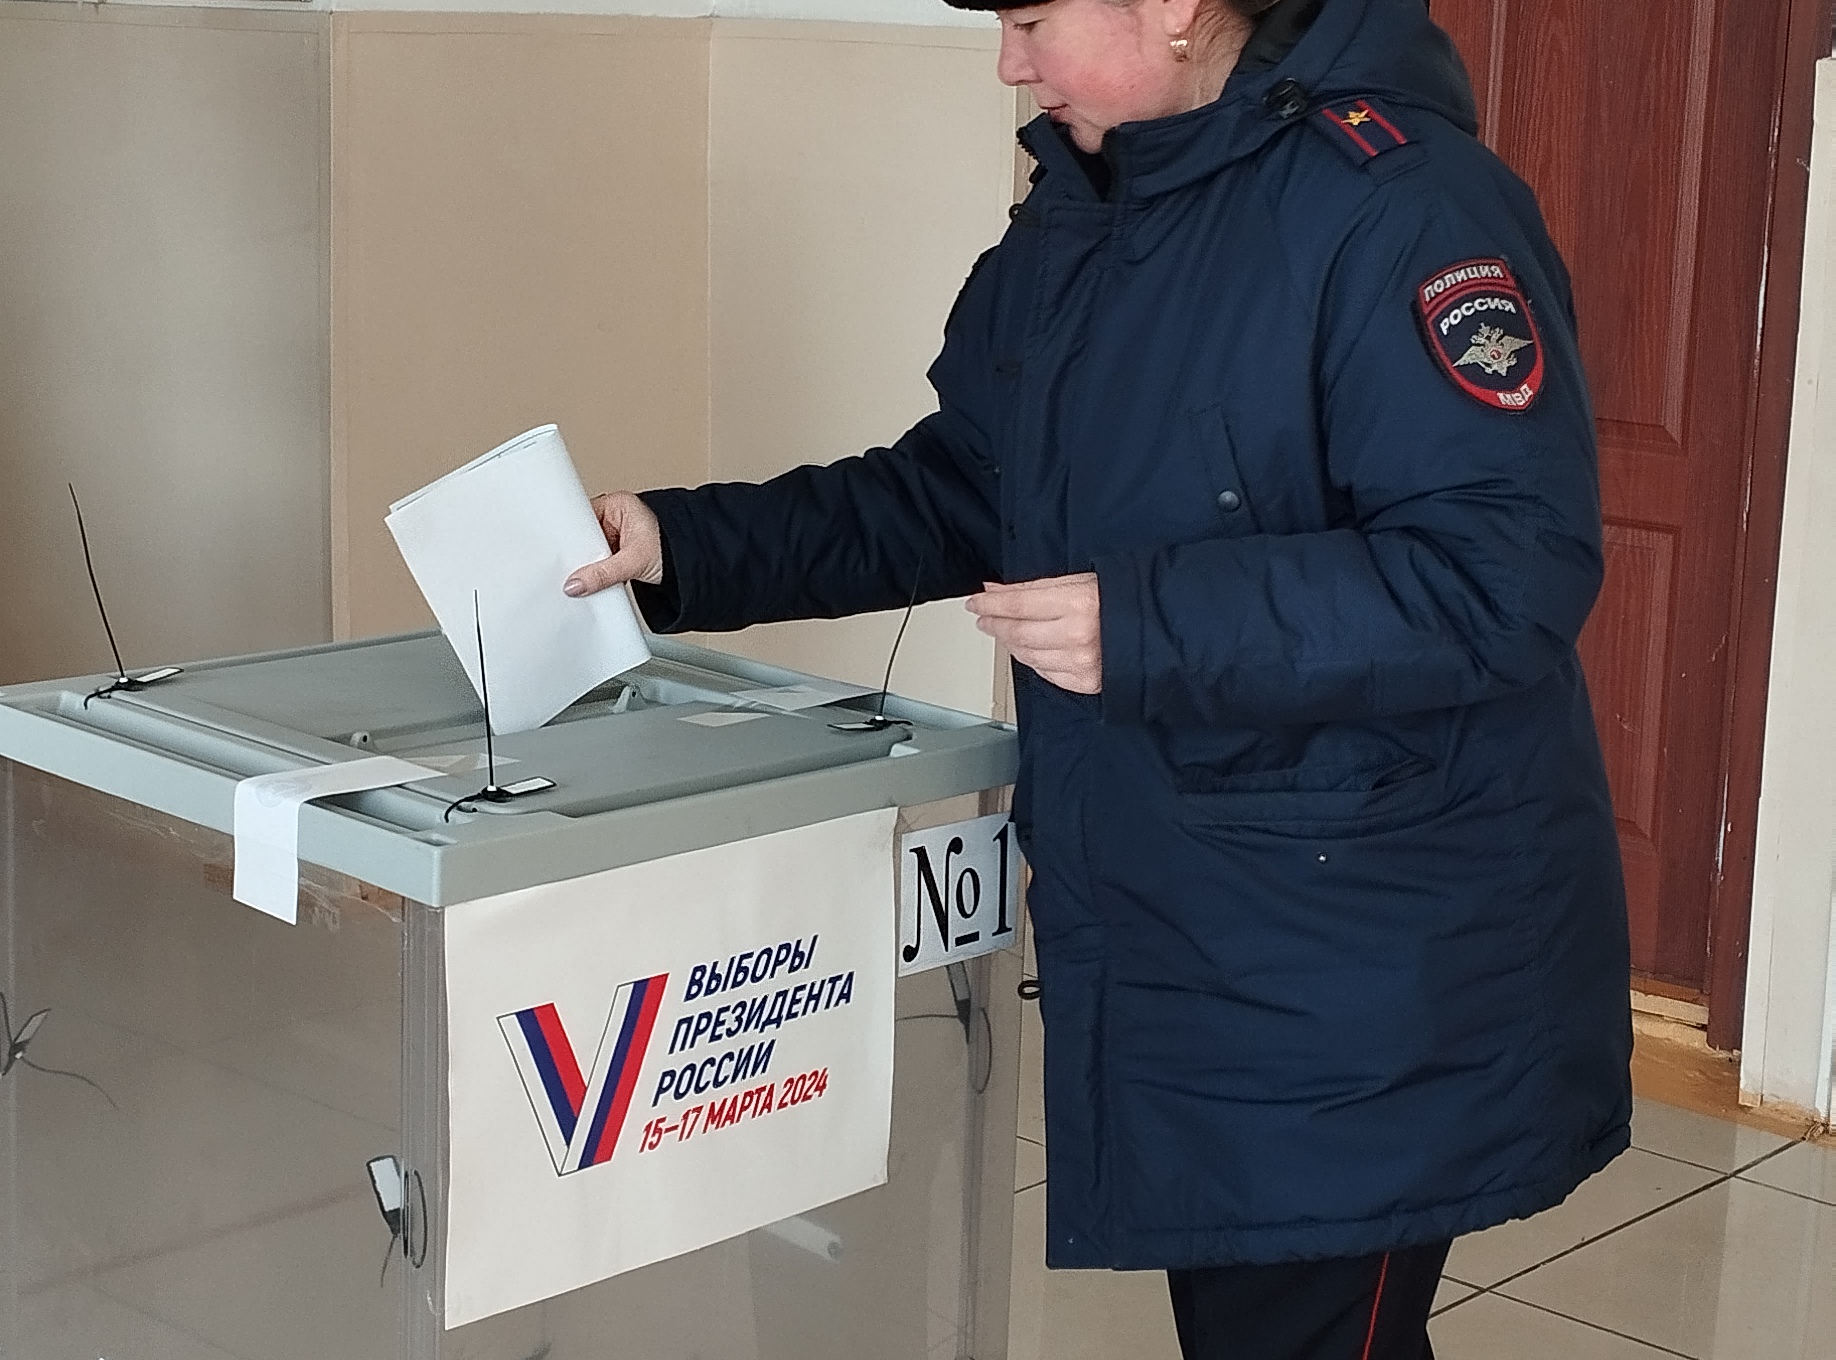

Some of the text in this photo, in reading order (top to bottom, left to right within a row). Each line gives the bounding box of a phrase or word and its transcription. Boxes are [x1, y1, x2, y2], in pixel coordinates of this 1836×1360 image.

[1423, 265, 1504, 302] ПОЛИЦИЯ
[1439, 297, 1516, 336] РОССИЯ
[1497, 383, 1533, 406] МВД
[683, 934, 819, 1002] ВЫБОРЫ
[668, 971, 855, 1055] ПРЕЗИДЕНТА
[651, 1038, 777, 1108] РОССИИ
[702, 1082, 776, 1134] МАРТА
[776, 1067, 828, 1111] 2024
